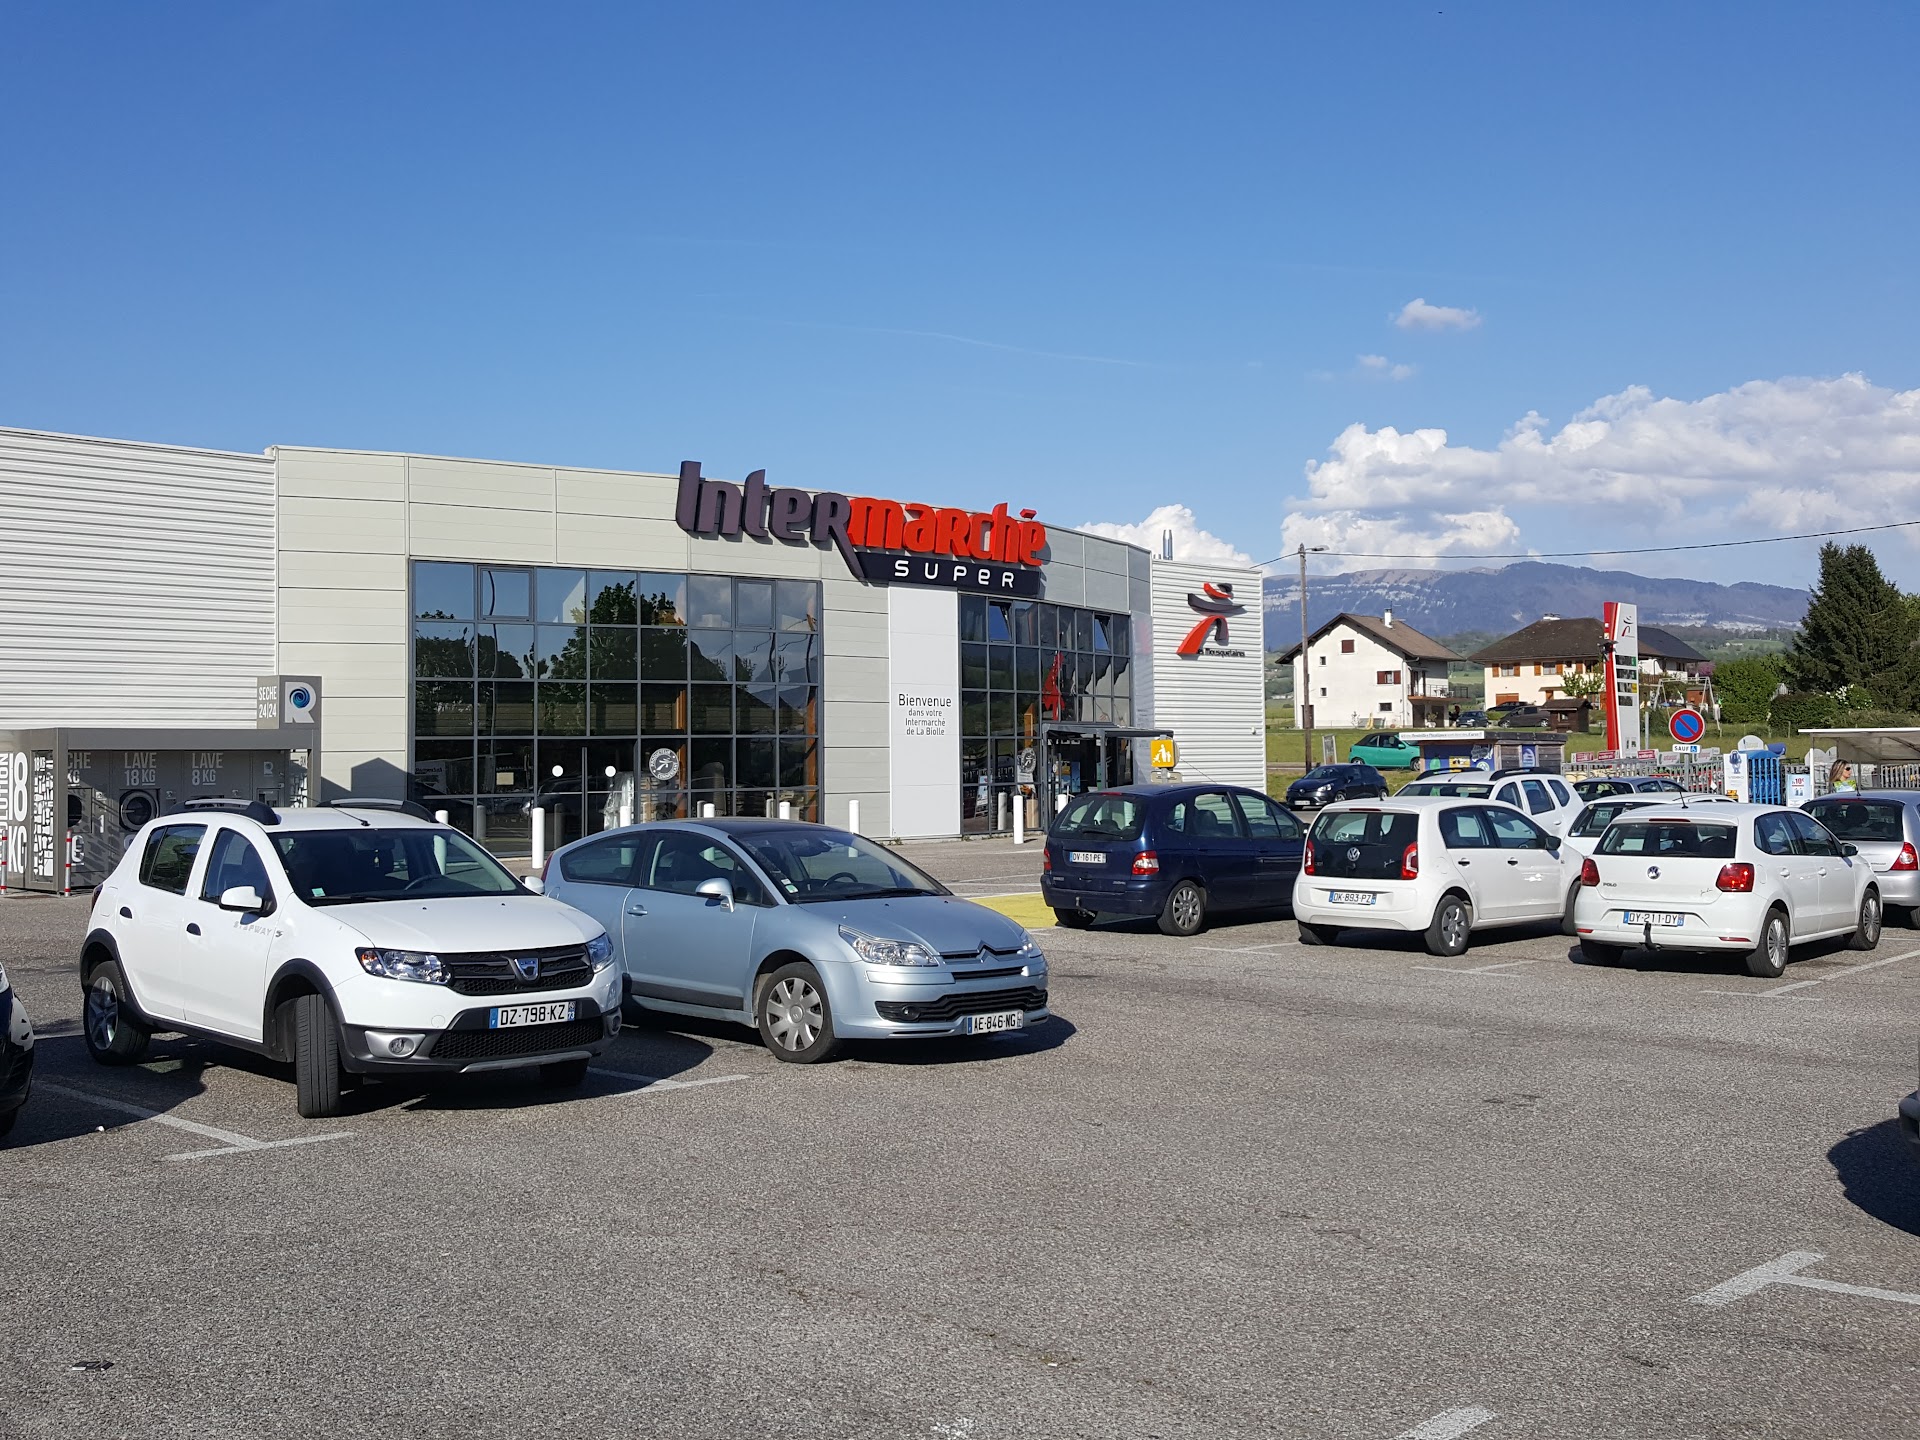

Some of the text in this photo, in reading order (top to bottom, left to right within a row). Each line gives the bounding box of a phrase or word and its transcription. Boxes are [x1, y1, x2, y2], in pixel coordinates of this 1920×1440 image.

[894, 559, 1015, 589] SUPER
[258, 686, 277, 701] SECHE
[898, 693, 952, 707] Bienvenue
[908, 708, 943, 717] dans votre
[905, 717, 946, 727] Intermarché
[906, 727, 945, 736] de La Biolle
[124, 752, 157, 769] LAVE
[192, 752, 224, 769] LAVE
[124, 769, 156, 786] 18 KG
[192, 769, 216, 786] 8 KG
[233, 920, 272, 936] SEPWAY
